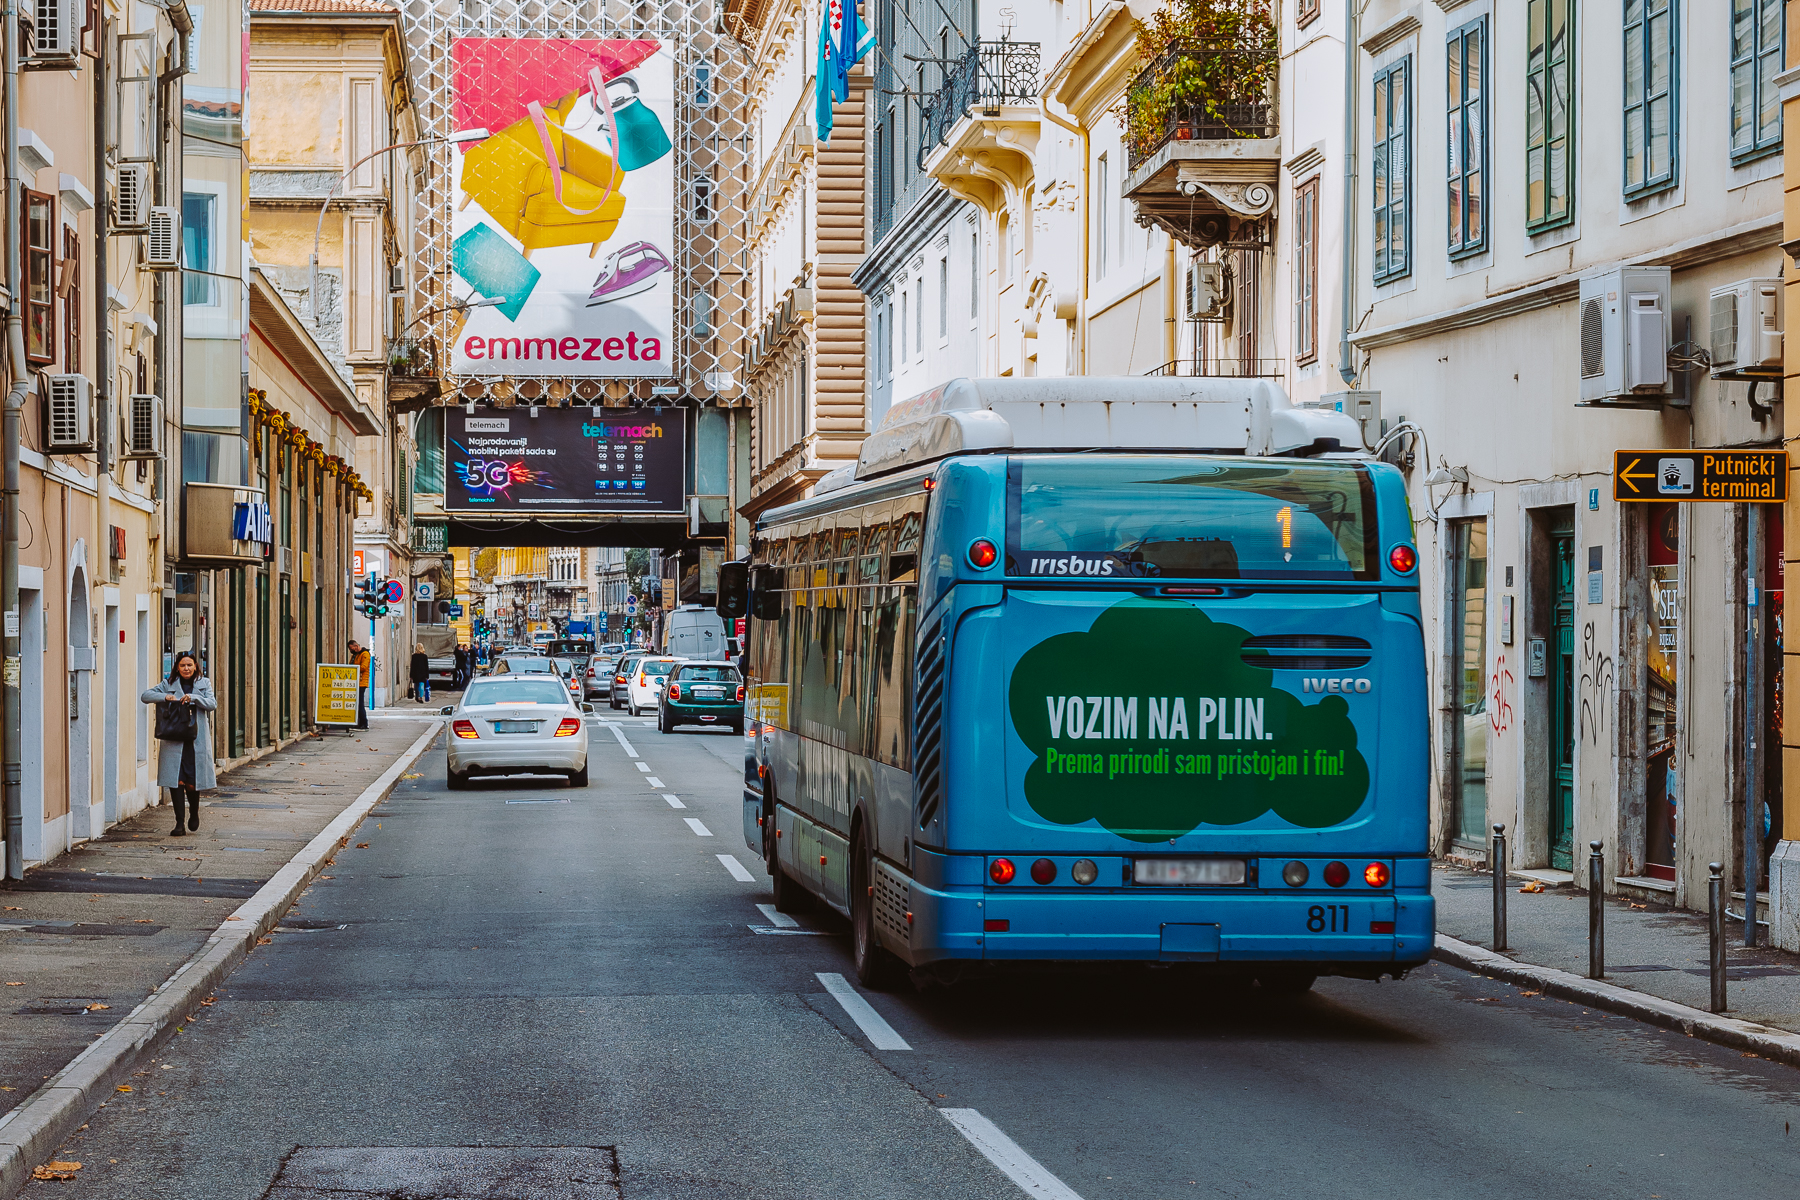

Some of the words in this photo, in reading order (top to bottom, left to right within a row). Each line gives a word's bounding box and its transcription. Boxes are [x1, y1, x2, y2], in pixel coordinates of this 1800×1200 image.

[464, 331, 661, 361] emmezeta
[469, 421, 506, 429] telemach
[581, 422, 663, 438] telemach
[468, 447, 498, 456] mobilni
[499, 447, 525, 457] paketi
[525, 447, 546, 456] sada
[465, 459, 511, 488] 5G
[1703, 455, 1775, 475] Putnički
[1702, 477, 1775, 498] terminal
[1276, 506, 1291, 548] 1
[1029, 555, 1114, 576] irisbus
[1303, 678, 1371, 693] IVECO
[1046, 696, 1138, 740] VOZIM
[1148, 697, 1189, 740] NA
[1199, 697, 1273, 740] PLIN.
[1046, 748, 1103, 774] Prema
[1109, 748, 1169, 780] prirodi
[1175, 754, 1211, 774] sam
[1218, 749, 1298, 781] pristojan
[1303, 750, 1309, 775] i
[1314, 750, 1344, 775] fin!
[1306, 904, 1349, 933] 811
